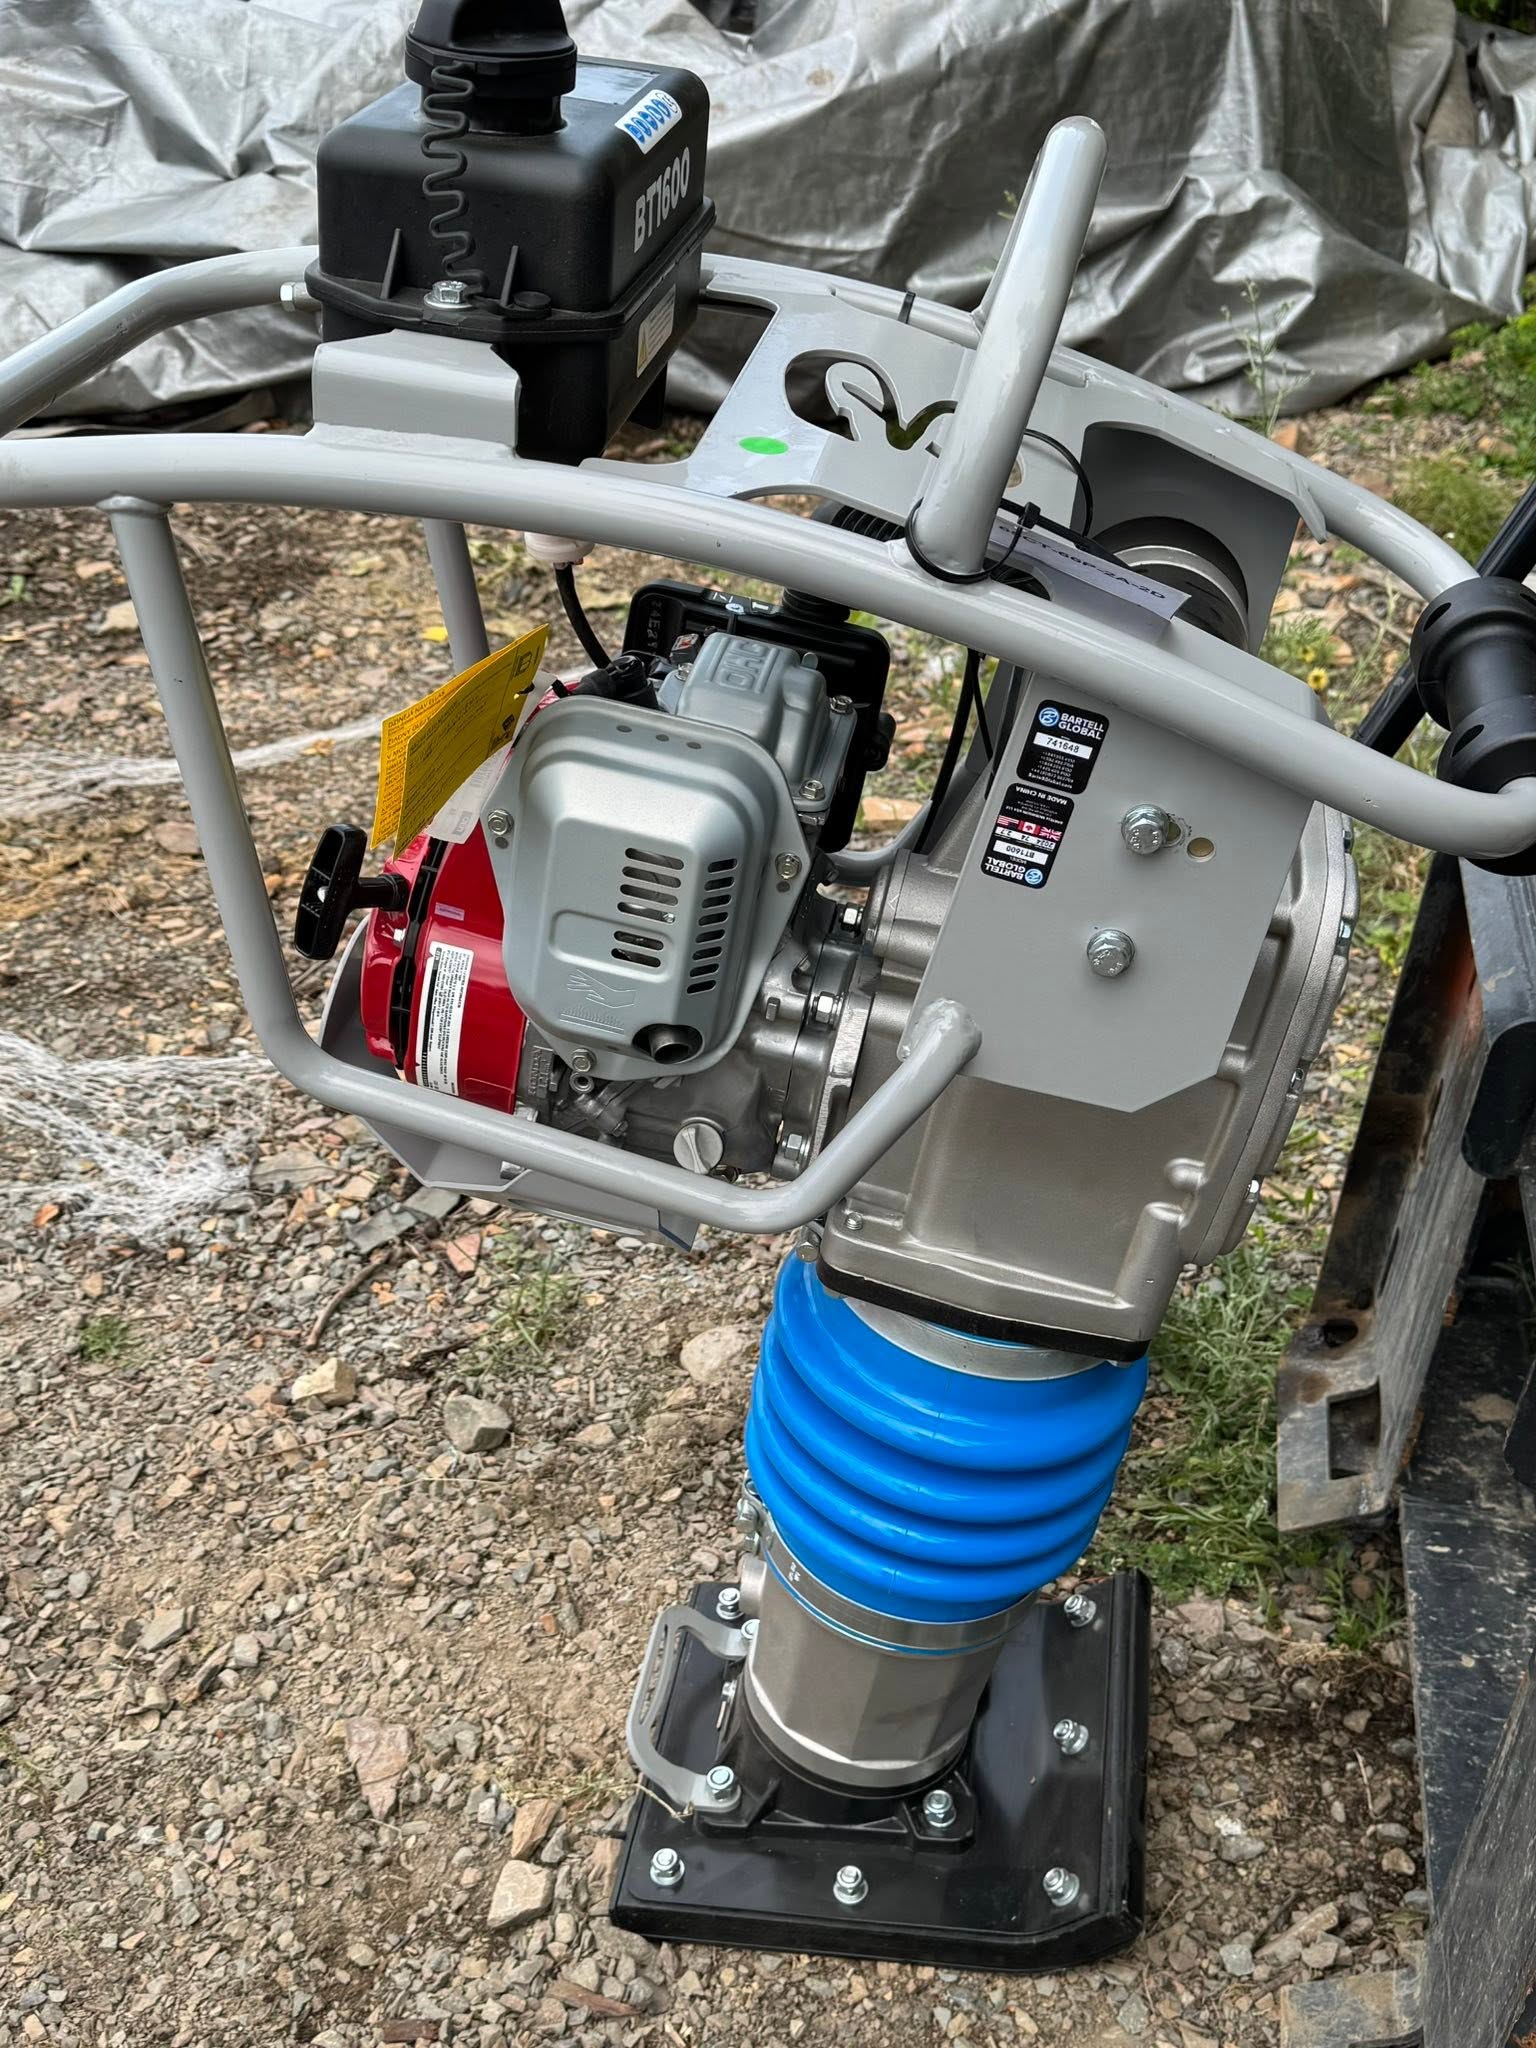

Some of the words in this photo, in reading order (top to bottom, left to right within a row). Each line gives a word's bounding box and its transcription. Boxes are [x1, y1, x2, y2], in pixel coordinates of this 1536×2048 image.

[634, 147, 690, 253] BT1600
[1058, 721, 1101, 740] GLOBAL
[1060, 713, 1104, 732] BARTELL
[1046, 737, 1080, 753] 741648
[1015, 786, 1037, 796] CHINA
[1047, 795, 1067, 805] MADE
[1006, 845, 1035, 858] BT1600
[1036, 839, 1053, 848] 2024
[985, 863, 1024, 880] BARTELL
[987, 856, 1026, 873] GLOBAL
